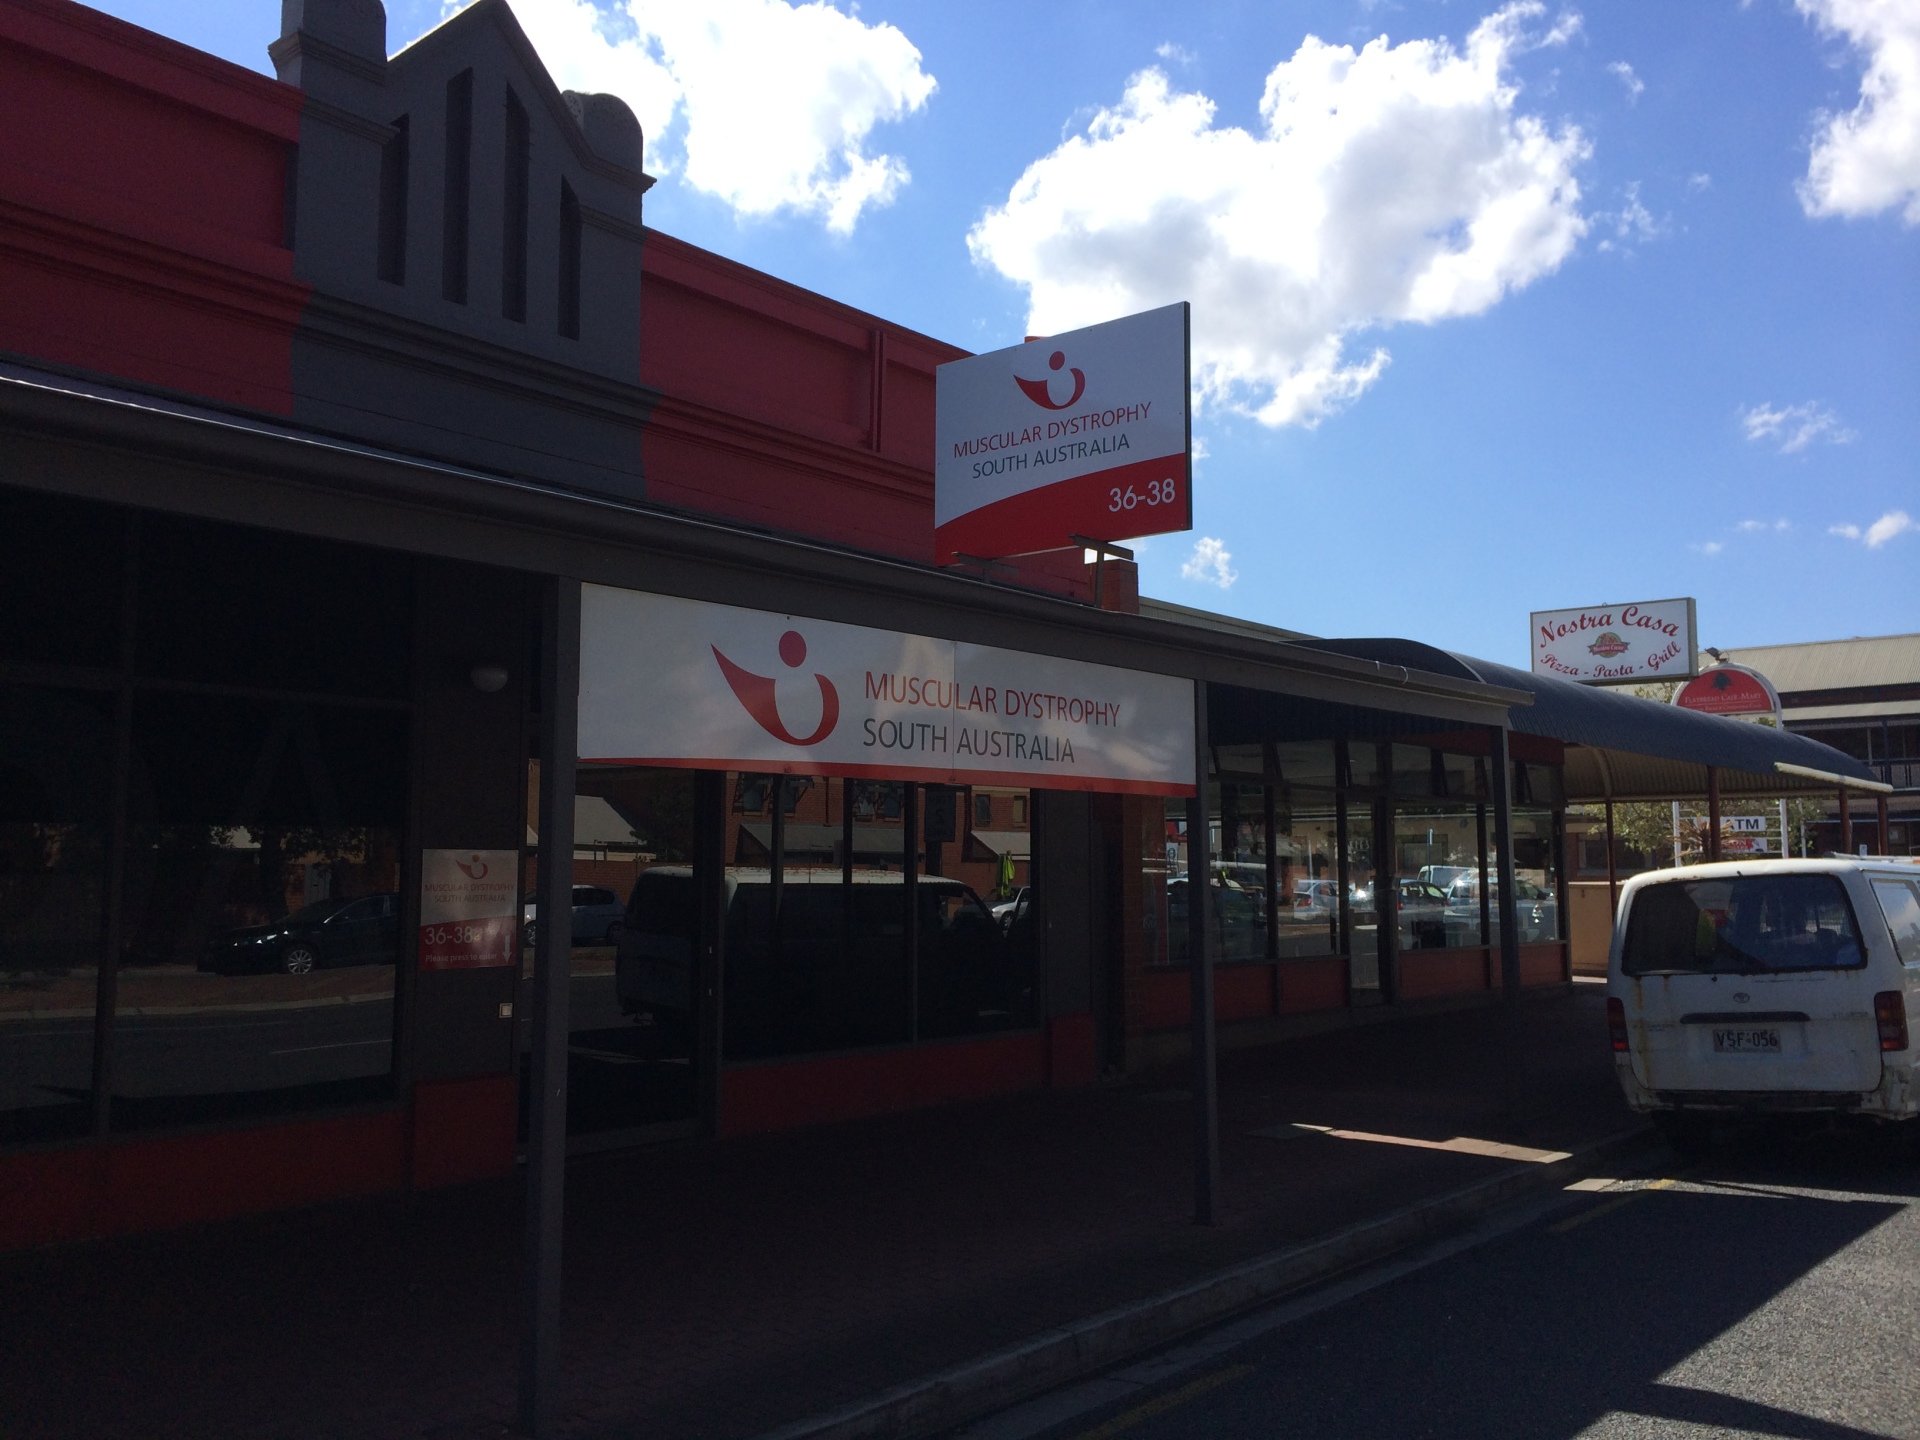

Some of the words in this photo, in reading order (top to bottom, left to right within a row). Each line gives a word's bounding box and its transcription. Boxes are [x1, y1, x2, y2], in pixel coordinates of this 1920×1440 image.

[953, 425, 1042, 458] MUSCULAR
[1047, 401, 1152, 439] DYSTROPHY
[972, 453, 1028, 479] SOUTH
[1033, 433, 1130, 468] AUSTRALIA
[1108, 477, 1176, 512] 36-38
[1540, 613, 1614, 648] Nostra
[1621, 605, 1680, 637] Casa
[1540, 653, 1579, 676] Pizza
[1593, 664, 1635, 678] Pasta
[1647, 640, 1682, 671] Grill
[865, 670, 998, 714] MUSCULAR
[1005, 689, 1121, 728] DYSTROPHY
[863, 718, 948, 752] SOUTH
[956, 727, 1076, 763] AUSTRALIA
[424, 883, 469, 892] MUSCULAR
[470, 882, 515, 892] DYSTROPHY
[464, 893, 506, 903] AUSTRALIA
